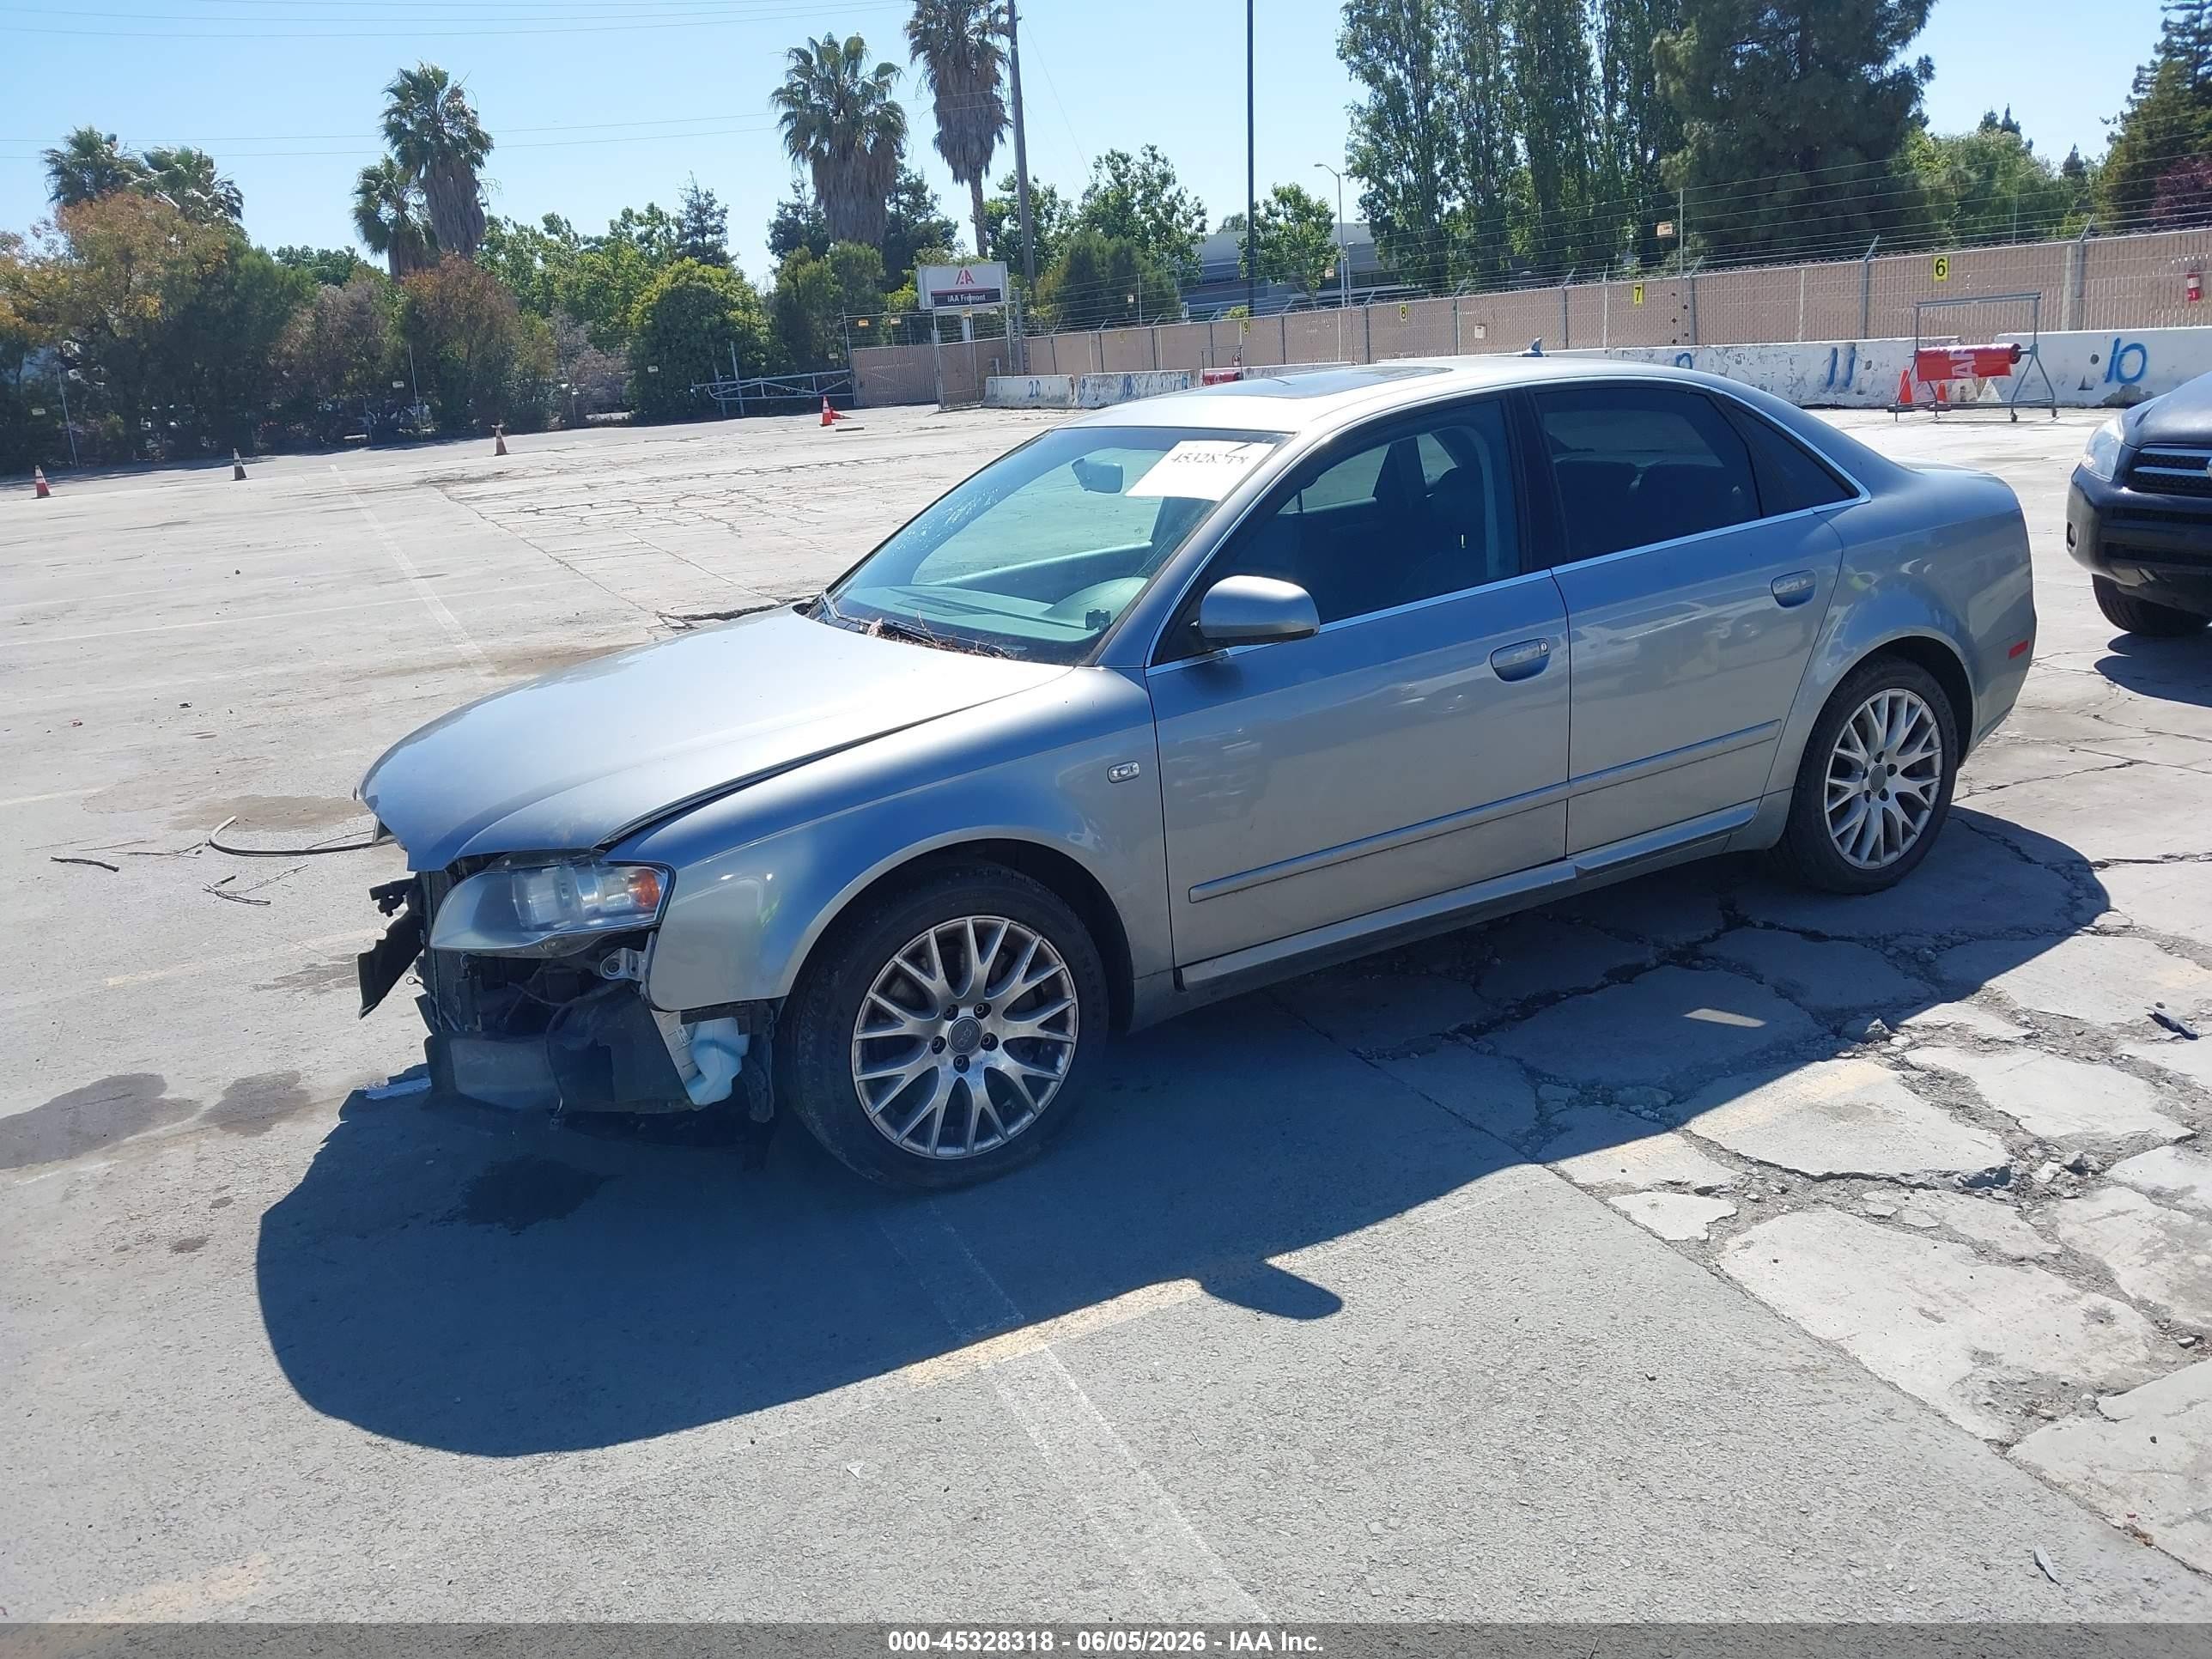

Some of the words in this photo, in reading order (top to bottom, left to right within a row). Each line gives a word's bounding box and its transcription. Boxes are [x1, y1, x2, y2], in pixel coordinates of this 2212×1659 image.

[1935, 258, 1946, 276] 6
[947, 294, 960, 302] IAA
[961, 293, 987, 302] Fremont
[1634, 286, 1642, 302] 7
[1401, 307, 1407, 319] 8
[1243, 321, 1249, 333] 9
[1826, 343, 1856, 383] 11
[2104, 337, 2148, 384] 10
[1028, 380, 1042, 398] 20
